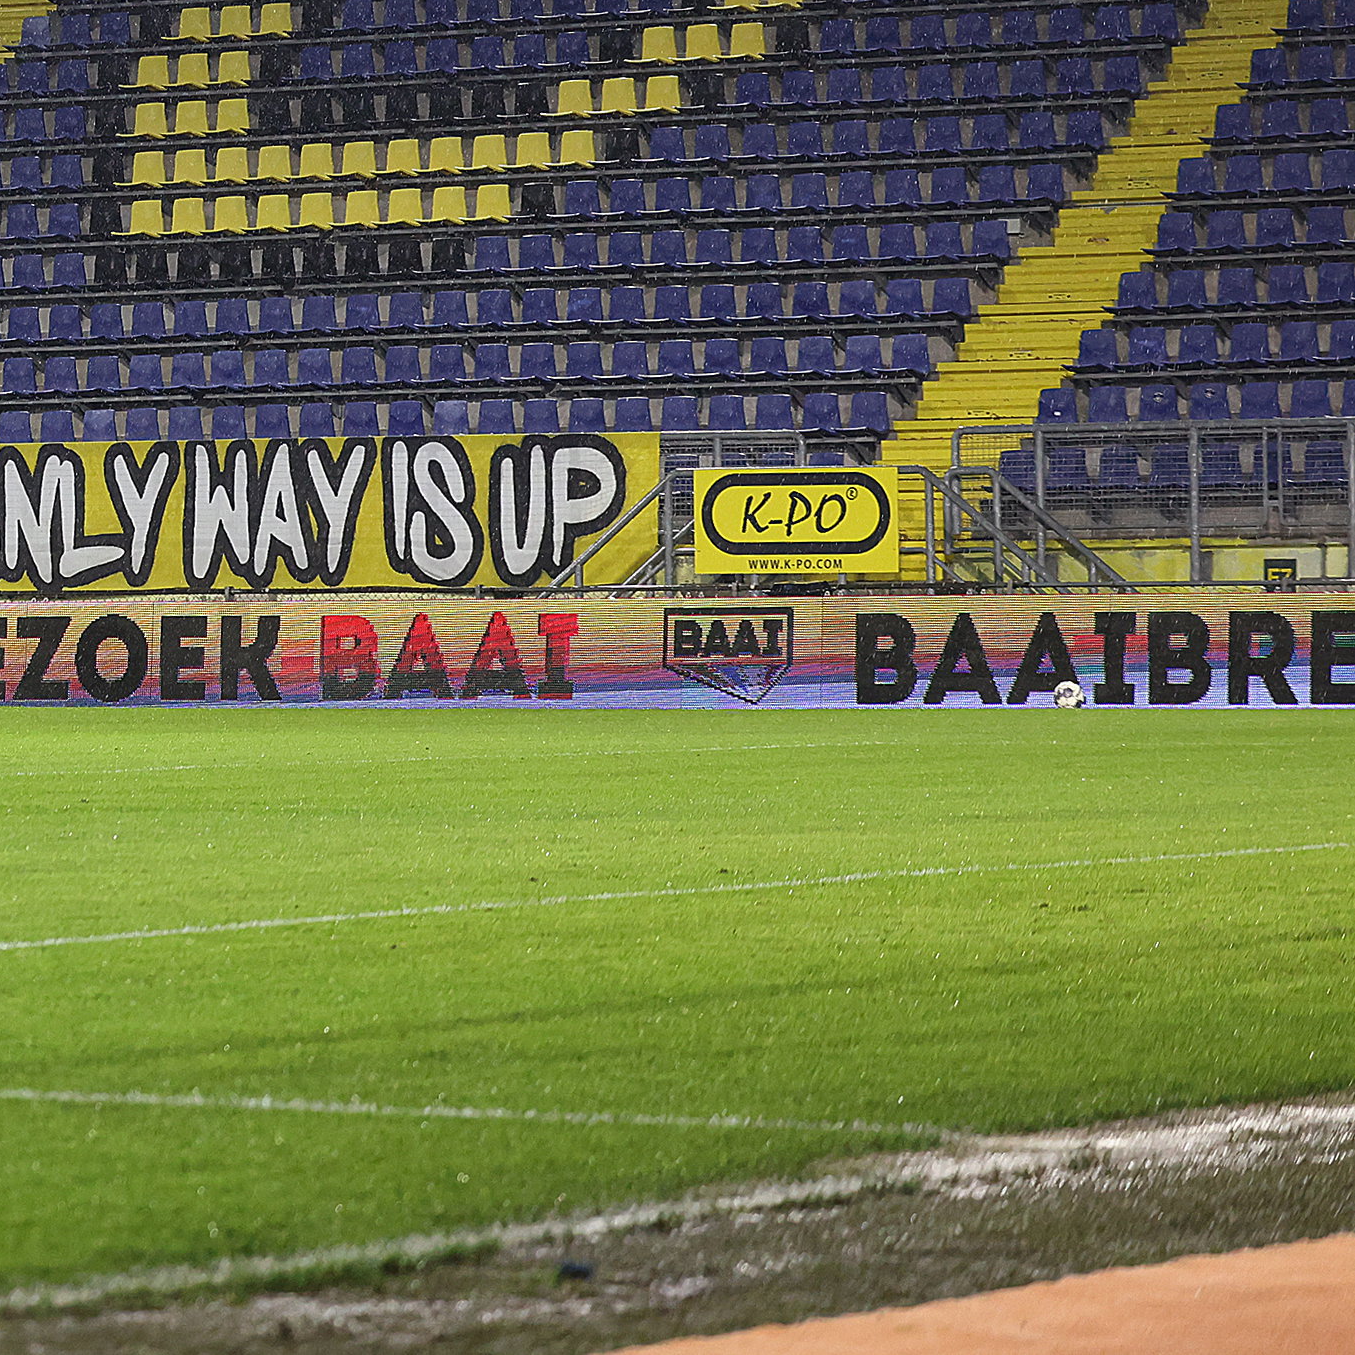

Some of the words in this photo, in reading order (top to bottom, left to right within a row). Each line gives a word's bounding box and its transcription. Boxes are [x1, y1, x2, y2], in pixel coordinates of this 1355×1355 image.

[189, 441, 370, 585] WAY
[387, 438, 478, 583] IS
[494, 439, 622, 581] UP
[747, 557, 843, 571] WWW.K-PO.COM
[320, 611, 578, 701] BAAI
[674, 619, 783, 657] BAAI
[855, 610, 1355, 706] BAAIBRE
